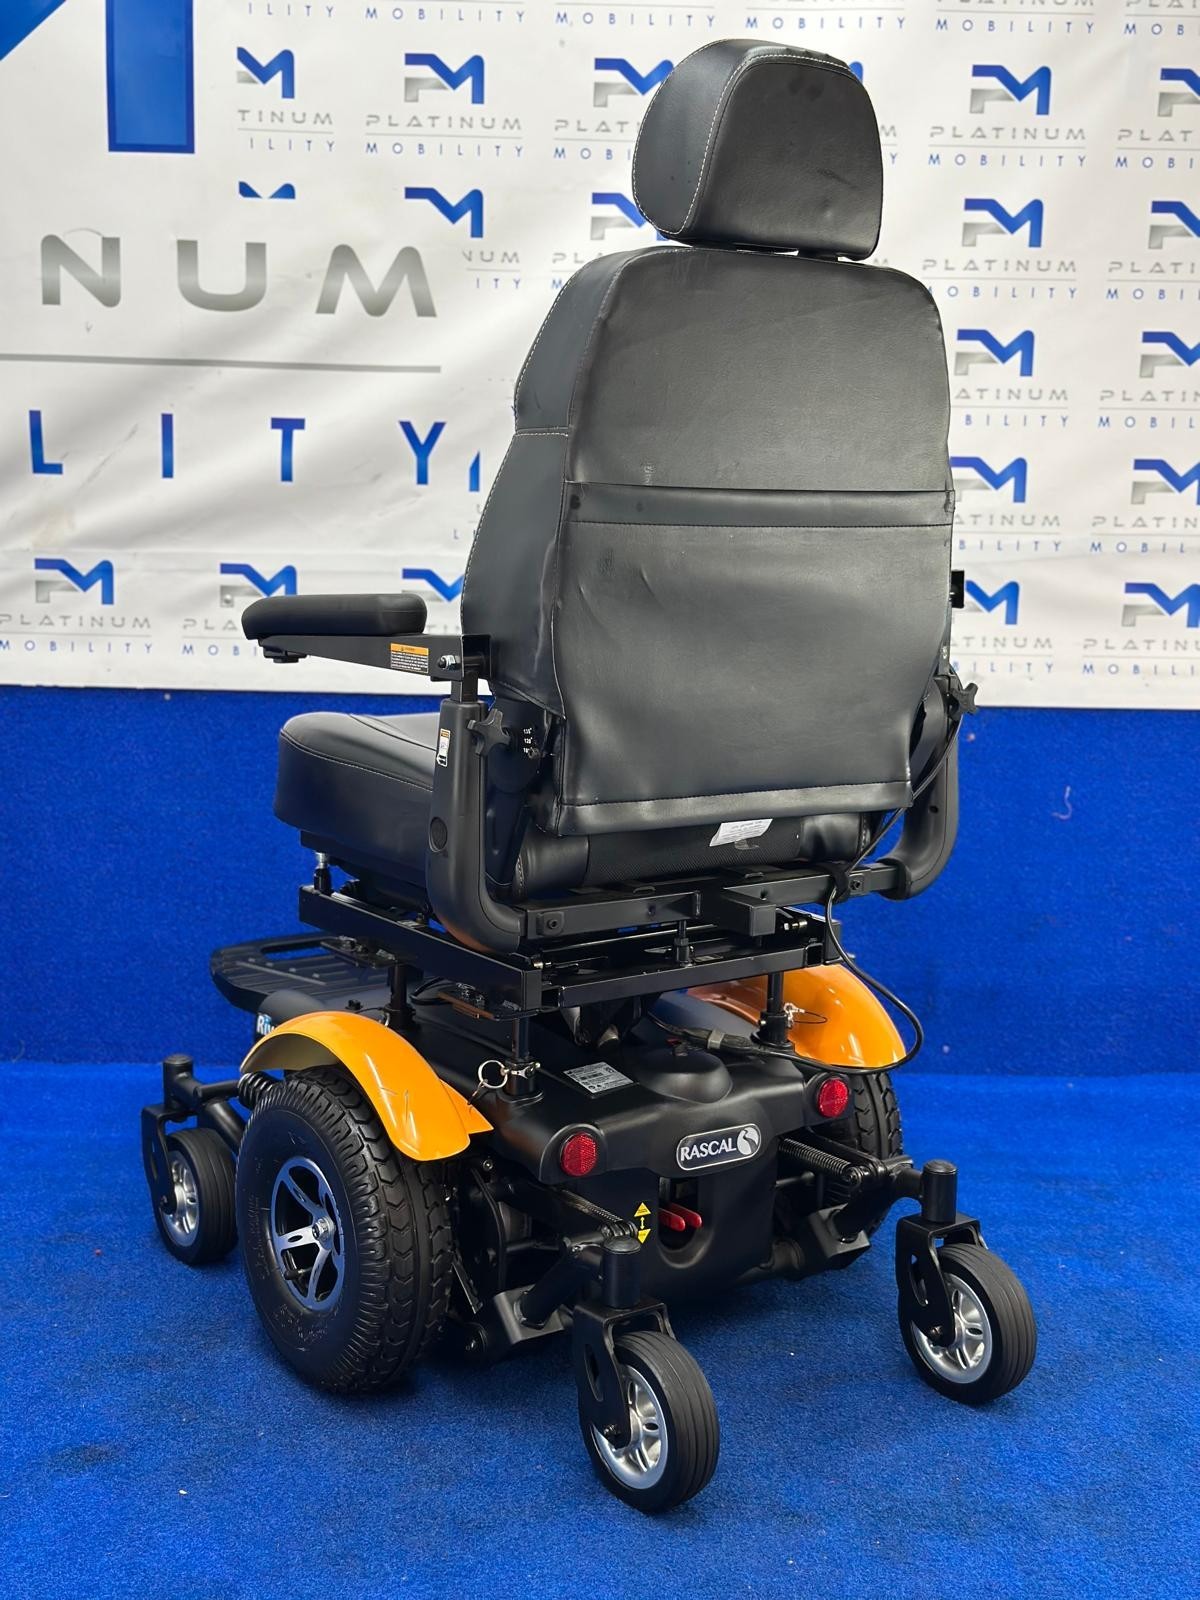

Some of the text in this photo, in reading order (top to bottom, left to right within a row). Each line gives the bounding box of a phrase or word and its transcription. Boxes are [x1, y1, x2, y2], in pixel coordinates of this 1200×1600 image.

[365, 8, 525, 22] MOBILITY
[555, 12, 715, 27] MOBILITY
[745, 16, 905, 29] MOBILITY
[935, 19, 1094, 33] MOBILITY
[1124, 24, 1200, 36] MOB
[365, 114, 522, 130] PLATINUM
[929, 126, 1086, 140] PLATINUM
[365, 142, 523, 156] MOBILITY
[928, 153, 1086, 167] MOBILITY
[921, 259, 1077, 273] PLATINUM
[41, 235, 437, 318] NUM
[29, 410, 447, 485] LITY
[0, 613, 151, 628] PLATINUM
[0, 640, 152, 653] MOBILITY
[680, 1137, 737, 1162] RASCAL
